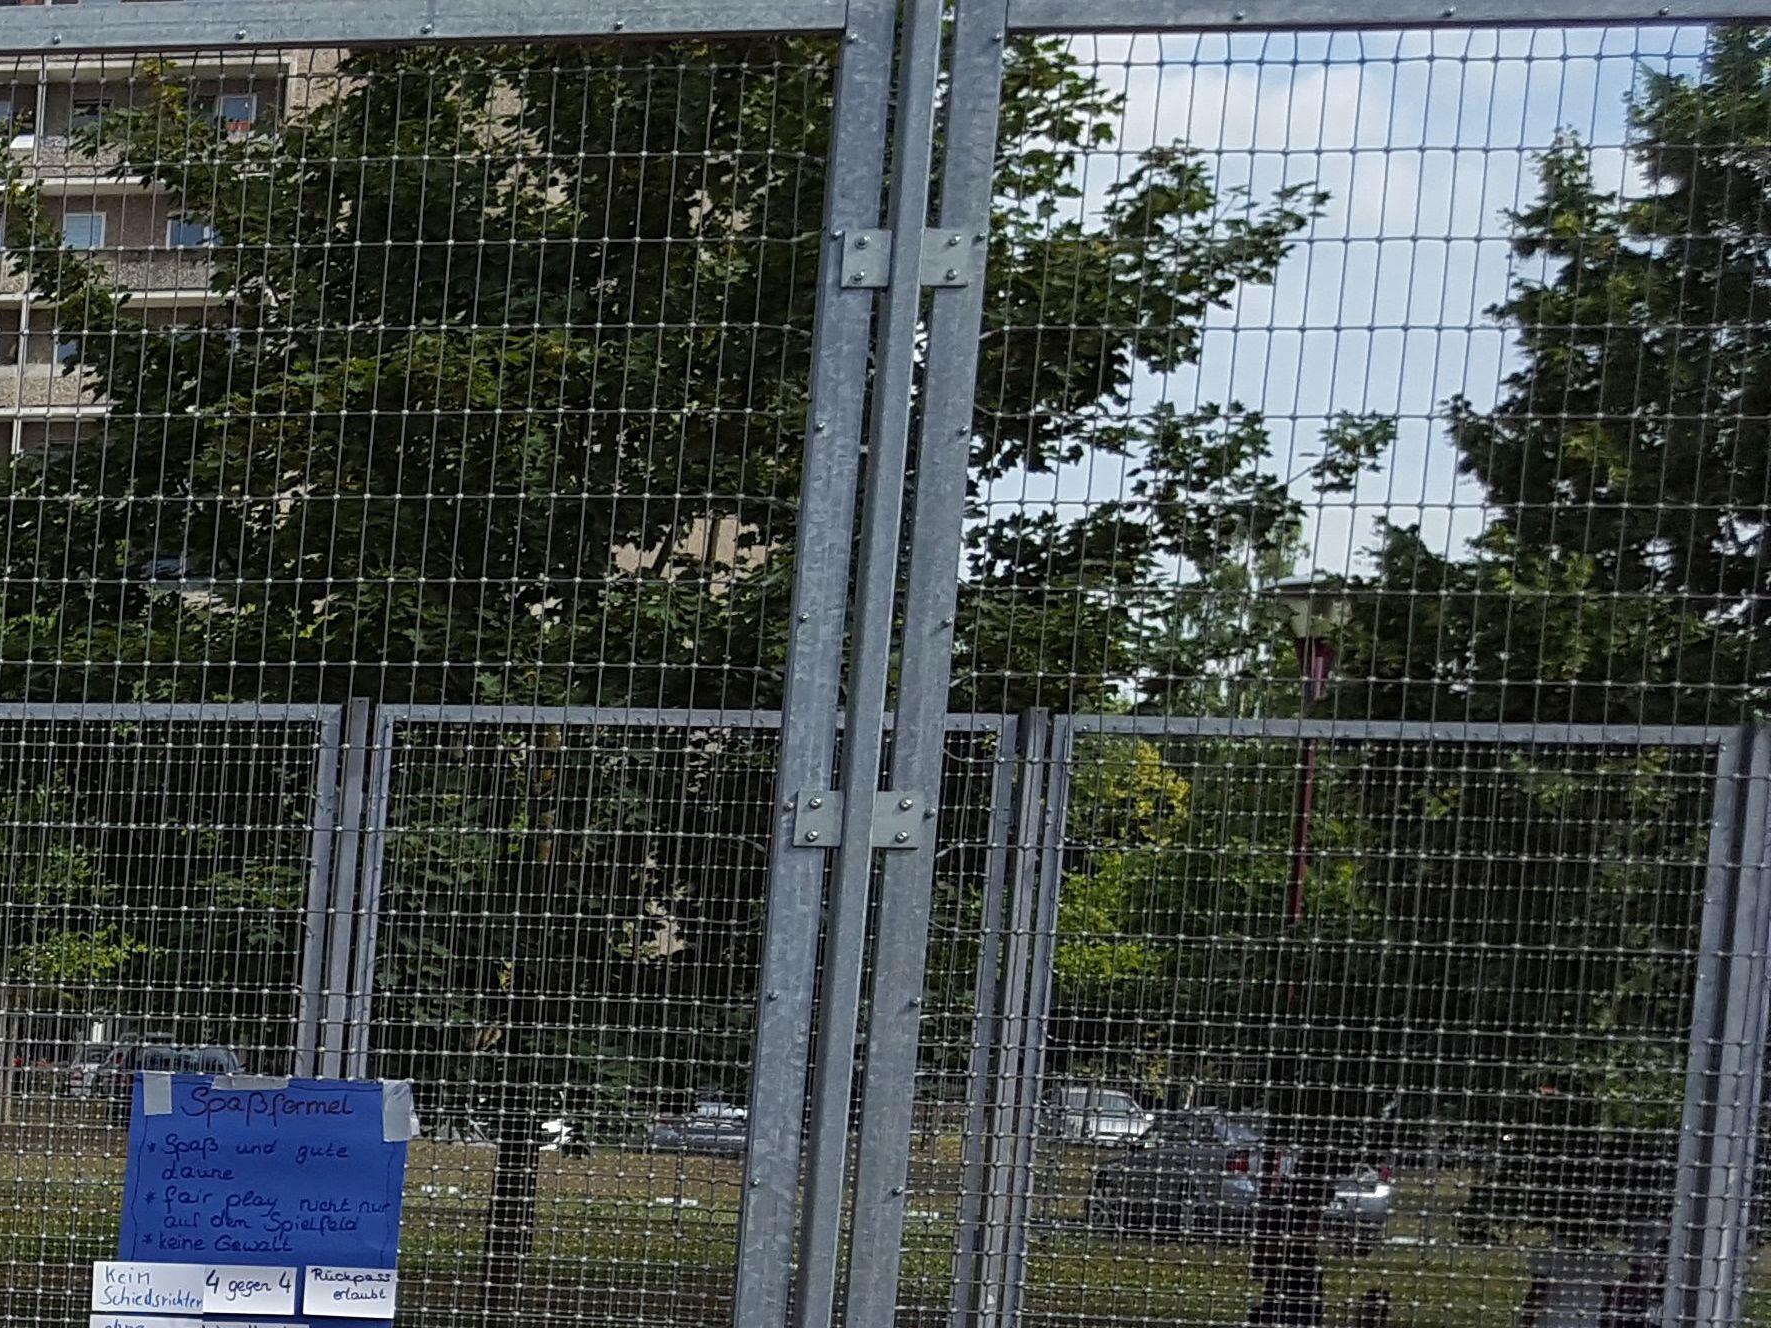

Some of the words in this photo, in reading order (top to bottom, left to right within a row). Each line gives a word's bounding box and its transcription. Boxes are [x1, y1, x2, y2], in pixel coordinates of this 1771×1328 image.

[181, 1086, 353, 1128] Spaßformel
[161, 1133, 219, 1161] Spaß
[236, 1140, 276, 1155] und
[295, 1142, 348, 1164] gute
[226, 1190, 277, 1217] play
[300, 1198, 351, 1213] nicht
[358, 1200, 391, 1215] nur
[164, 1212, 201, 1230] auf
[263, 1211, 359, 1237] Spielfeld
[214, 1234, 293, 1253] Gewalt
[205, 1269, 220, 1294] 4
[226, 1280, 271, 1301] gegen
[278, 1271, 291, 1294] 4
[333, 1287, 386, 1300] erlaubt
